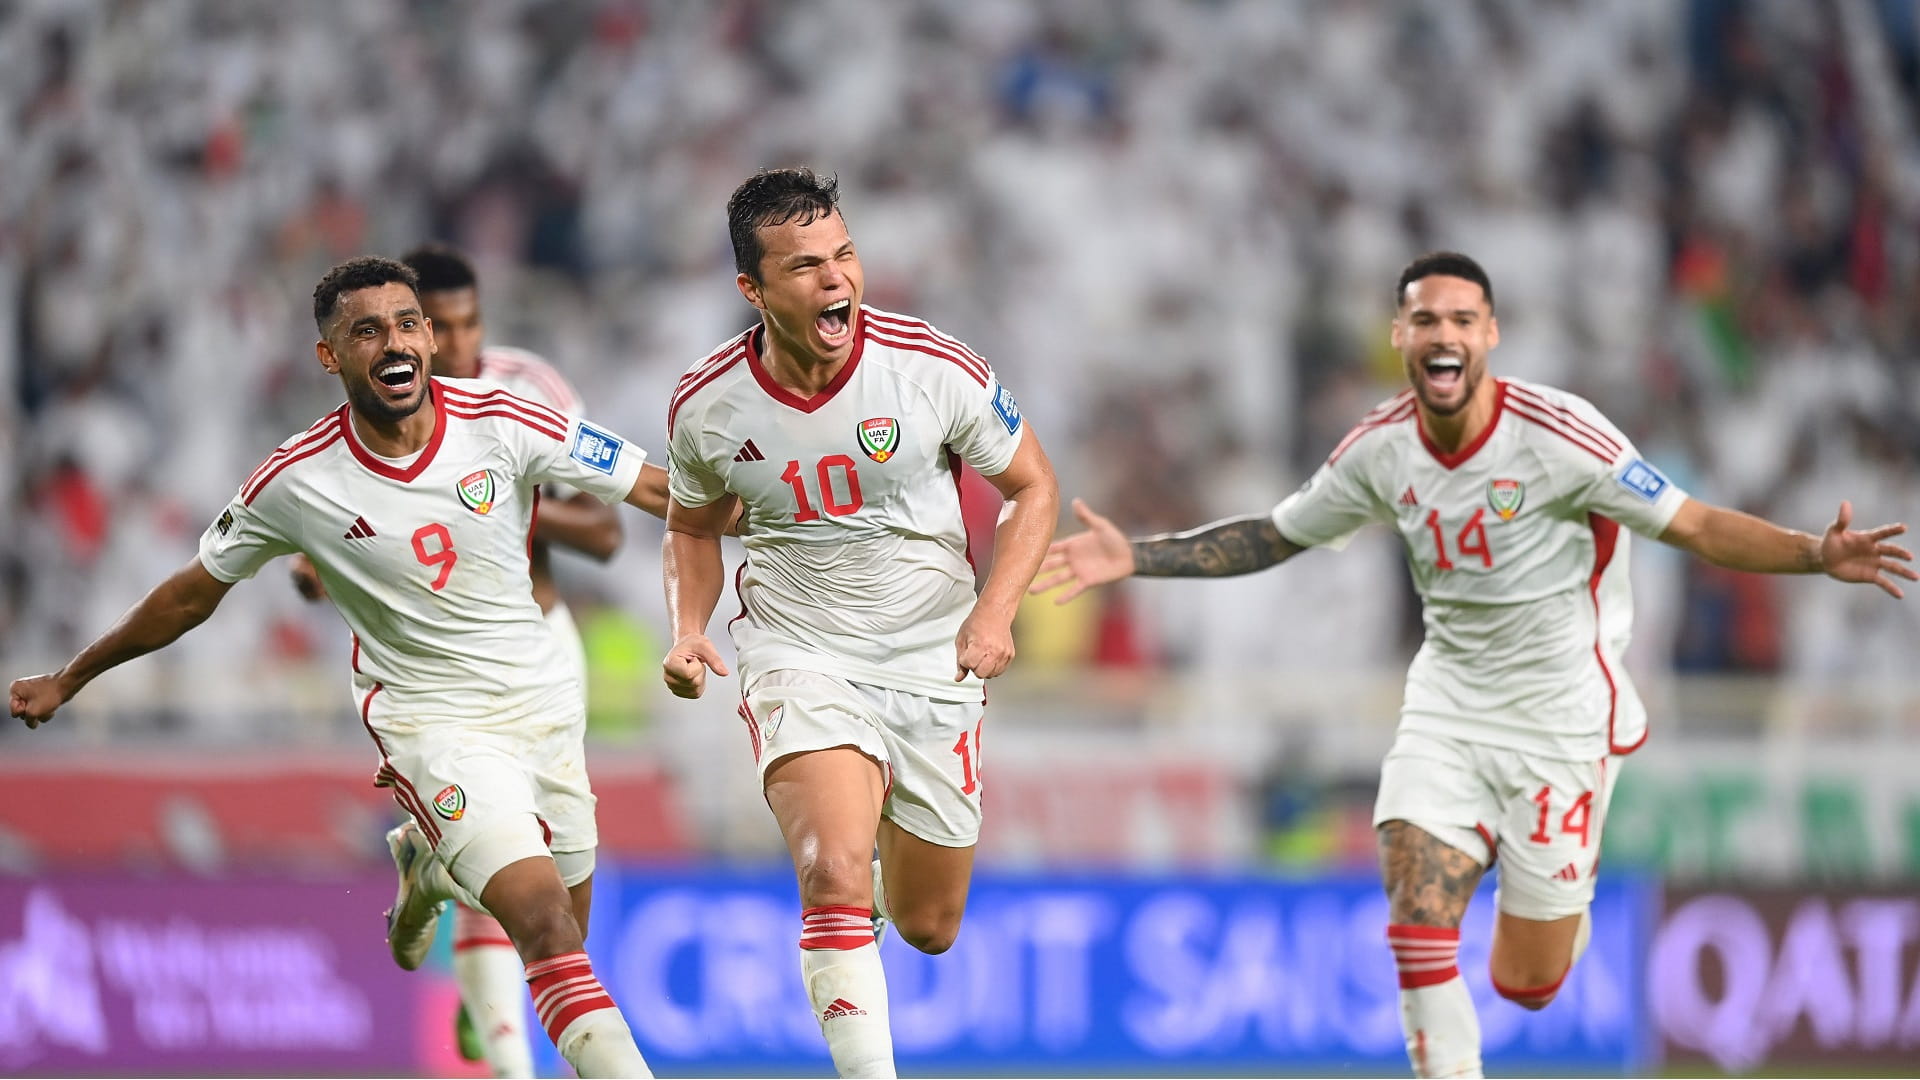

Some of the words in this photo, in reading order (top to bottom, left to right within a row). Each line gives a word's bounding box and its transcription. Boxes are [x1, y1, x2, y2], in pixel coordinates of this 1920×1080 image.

[869, 430, 889, 438] UAE
[468, 482, 484, 493] UAE
[780, 454, 864, 522] 10
[411, 522, 457, 591] 9
[1425, 507, 1494, 571] 14
[952, 730, 983, 796] 1
[1529, 785, 1594, 848] 14
[613, 889, 1100, 1057] CRDIT
[823, 1008, 868, 1022] adidas
